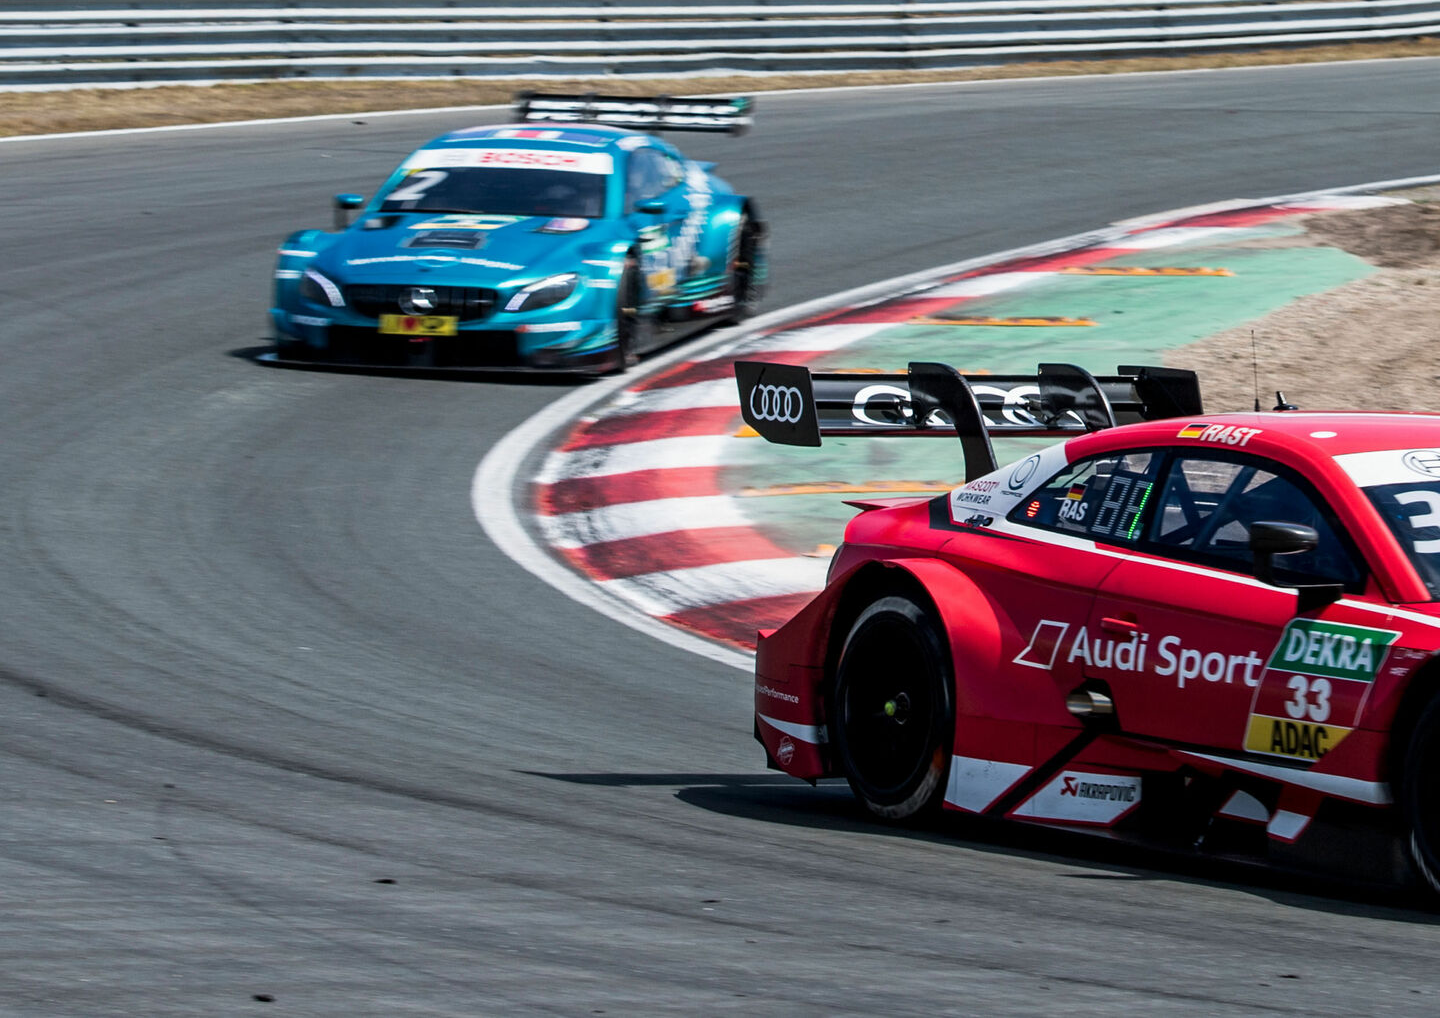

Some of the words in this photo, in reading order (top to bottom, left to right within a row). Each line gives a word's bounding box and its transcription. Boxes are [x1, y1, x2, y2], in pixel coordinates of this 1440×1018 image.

[385, 170, 449, 201] 2
[1200, 424, 1263, 446] RAST
[1058, 499, 1088, 521] RAS
[1067, 626, 1149, 672] Audi
[1154, 635, 1262, 688] Sport
[1284, 628, 1374, 673] DEKRA
[1285, 676, 1332, 722] 33
[1271, 720, 1329, 759] ADAC
